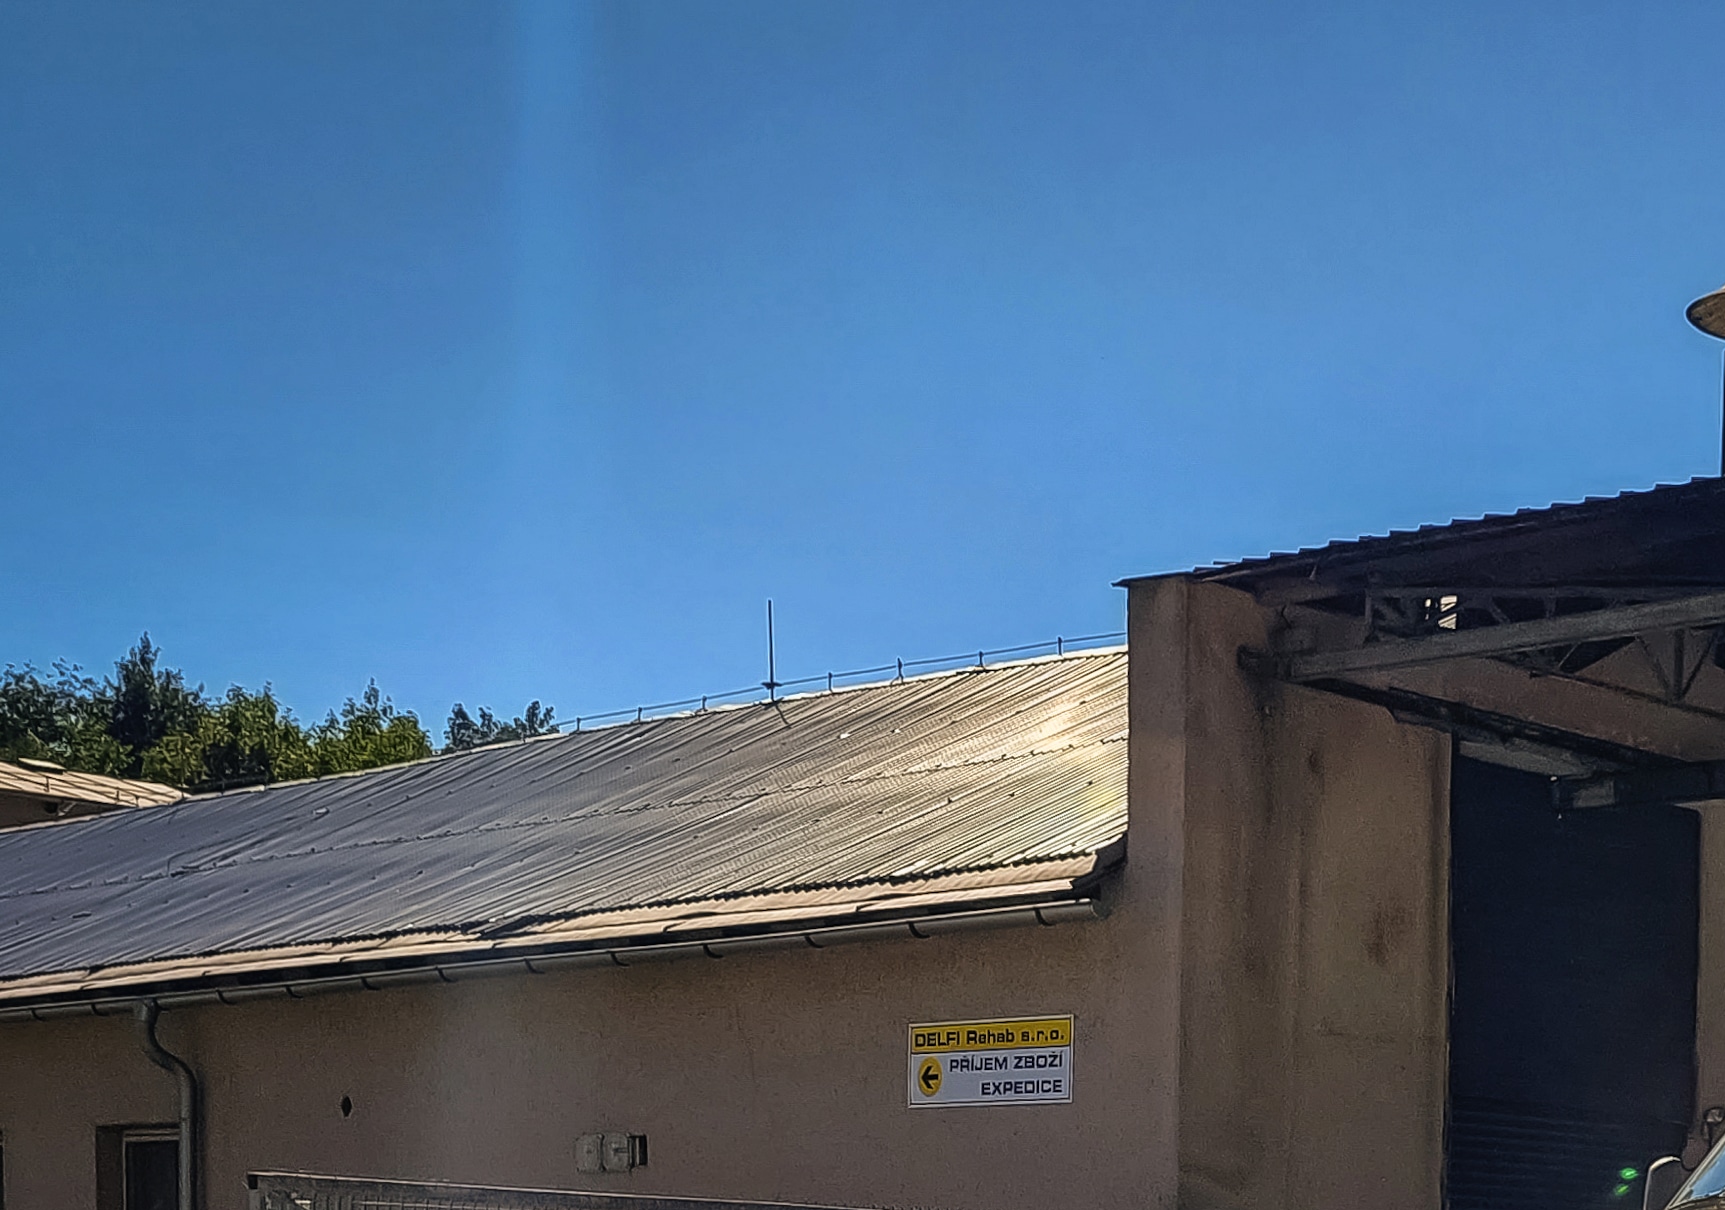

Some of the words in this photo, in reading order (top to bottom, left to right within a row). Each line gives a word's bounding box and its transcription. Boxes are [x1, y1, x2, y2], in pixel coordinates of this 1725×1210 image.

[914, 1031, 960, 1047] DELFI
[966, 1028, 1015, 1045] Rehab
[1021, 1029, 1065, 1042] s.r.o.
[950, 1055, 1008, 1072] PŘÍJEM
[1013, 1051, 1063, 1070] ZBOŽÍ
[981, 1080, 1062, 1096] EXPEDICE
